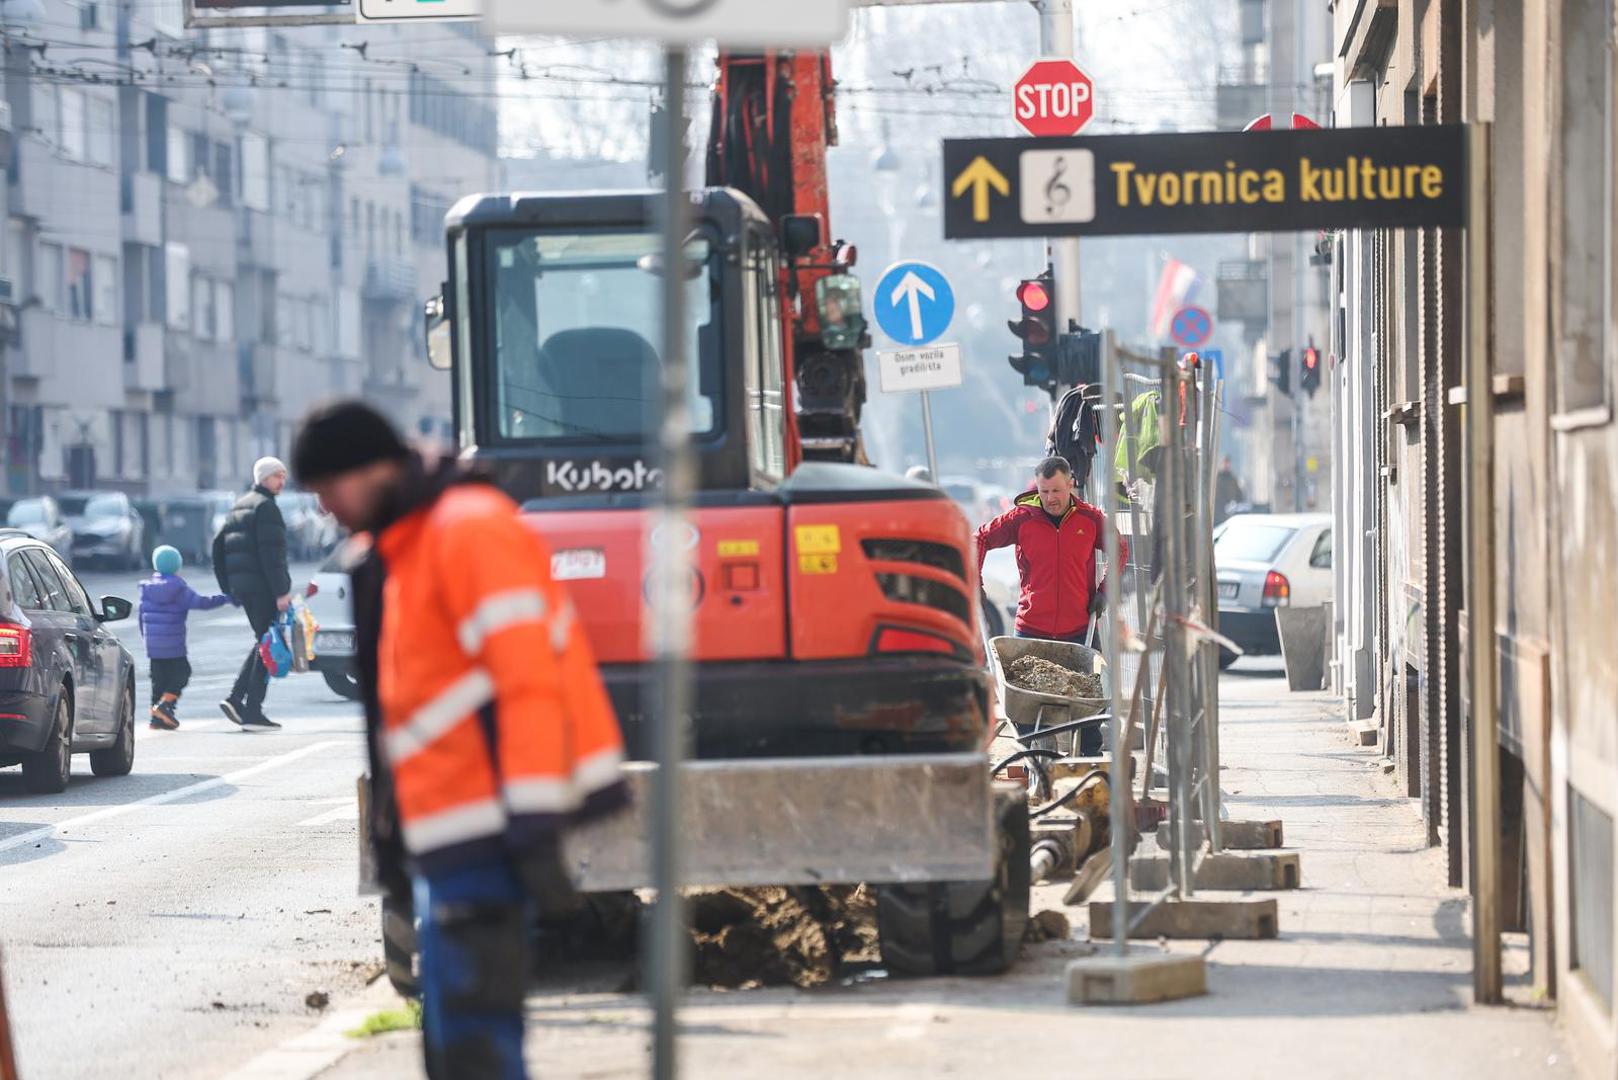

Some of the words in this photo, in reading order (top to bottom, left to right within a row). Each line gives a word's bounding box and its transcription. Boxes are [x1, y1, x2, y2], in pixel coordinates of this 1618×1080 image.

[1018, 82, 1089, 119] STOP
[1109, 160, 1285, 206] Tvornica
[1301, 156, 1442, 201] kulture
